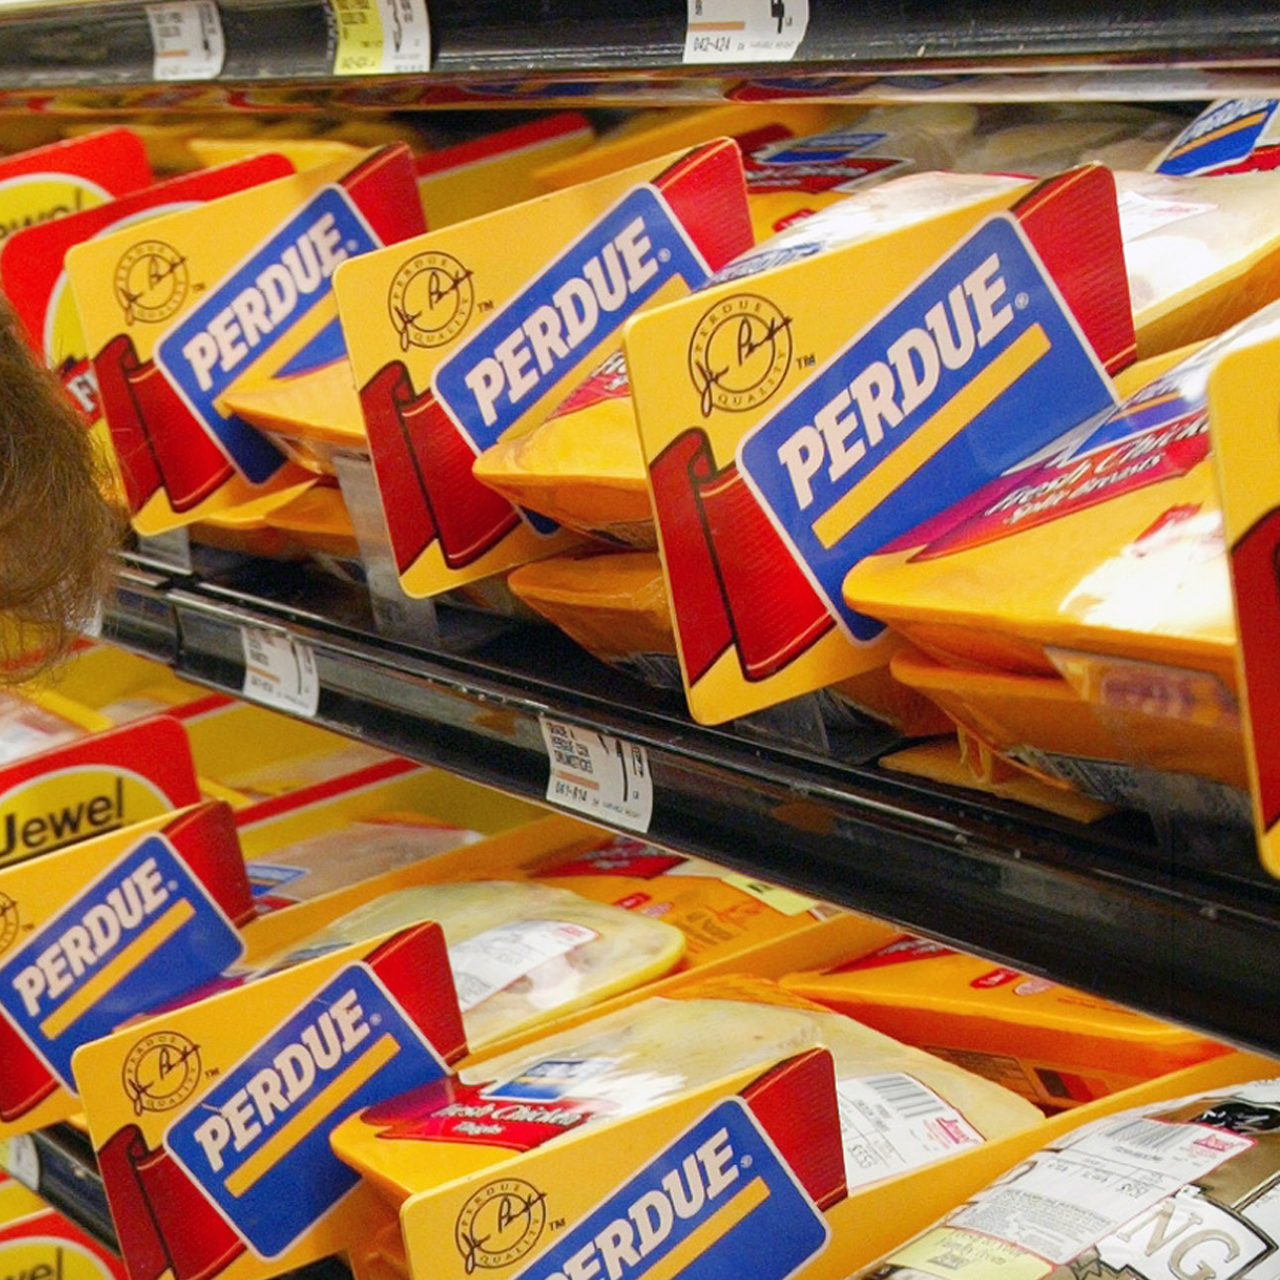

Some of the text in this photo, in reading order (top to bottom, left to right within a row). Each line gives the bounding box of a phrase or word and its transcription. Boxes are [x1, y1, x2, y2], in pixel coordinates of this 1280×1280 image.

[181, 211, 348, 392] PERDUE
[464, 216, 659, 428] PERDUE
[776, 252, 1015, 511] PERDUE
[11, 856, 172, 1017] PERDUE
[193, 989, 371, 1173] PERDUE
